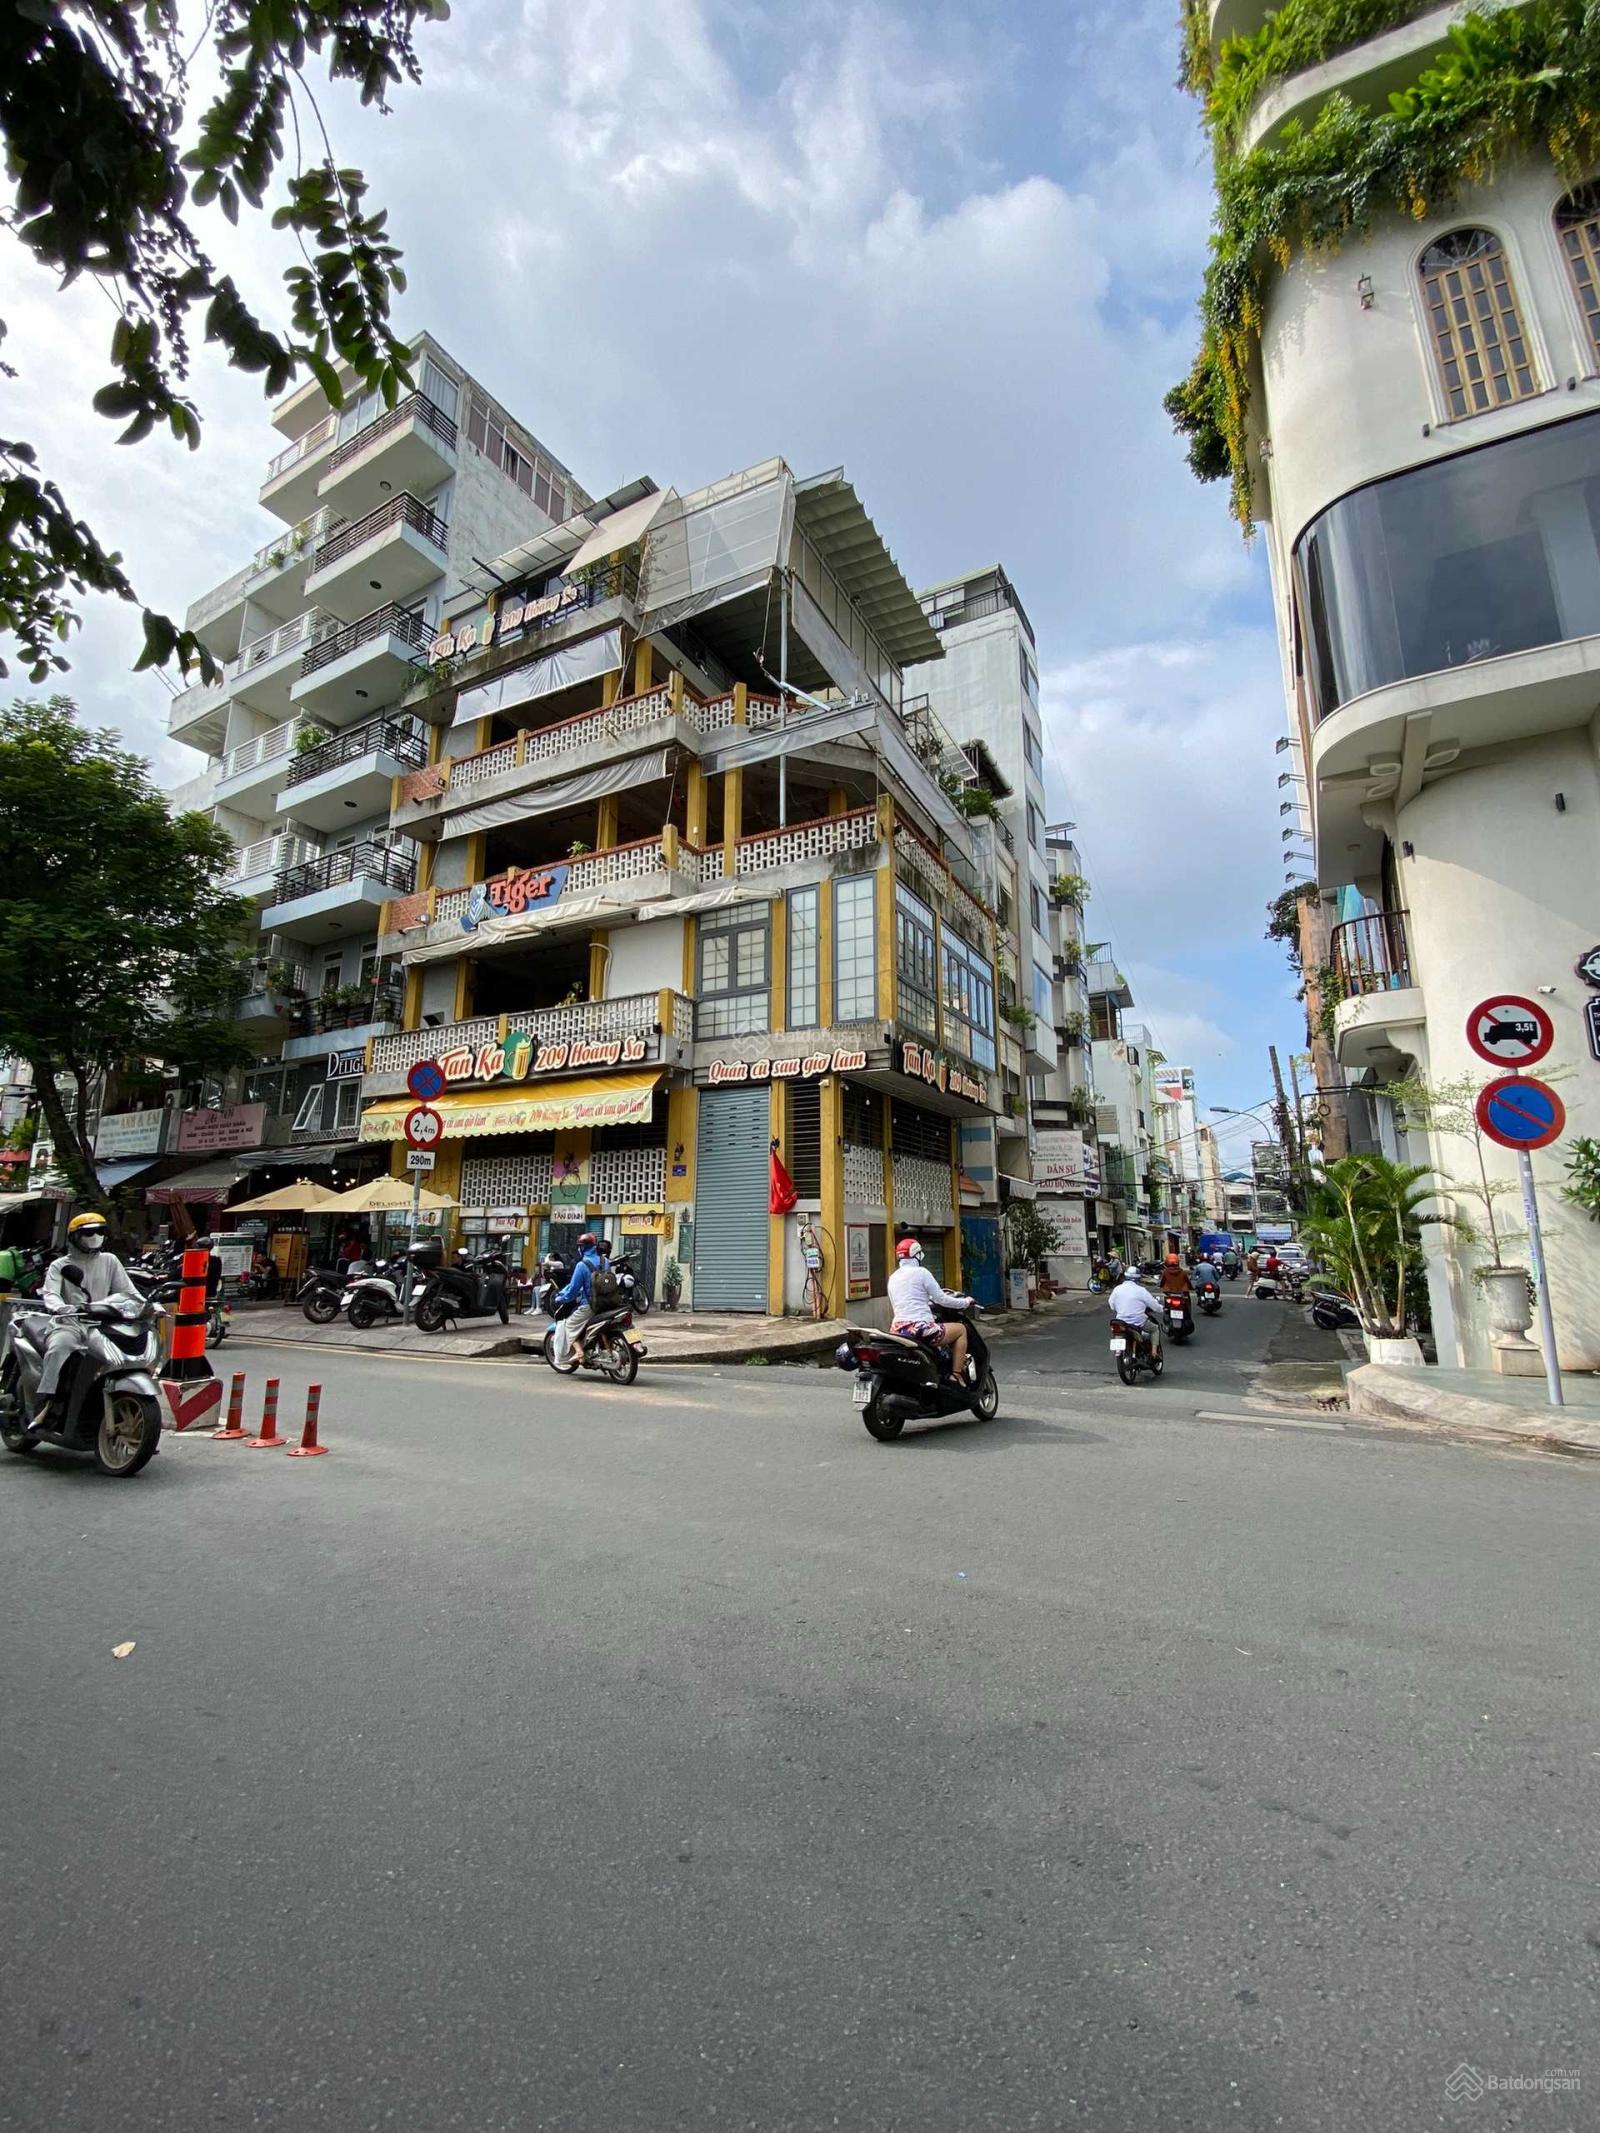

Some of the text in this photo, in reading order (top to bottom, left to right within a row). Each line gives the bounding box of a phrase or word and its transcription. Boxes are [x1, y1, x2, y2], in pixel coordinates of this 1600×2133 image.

[500, 608, 523, 632] 209
[490, 871, 551, 913] Tiger
[1515, 1023, 1534, 1032] 3,5t
[440, 1035, 646, 1080] Tan Ka 209 Hoàng Sa
[709, 1048, 866, 1085] Quán cũ sau giờ làm
[903, 1042, 921, 1075] Tan
[922, 1049, 936, 1084] Ka
[414, 1120, 435, 1134] 2,4m
[411, 1155, 431, 1165] 290m
